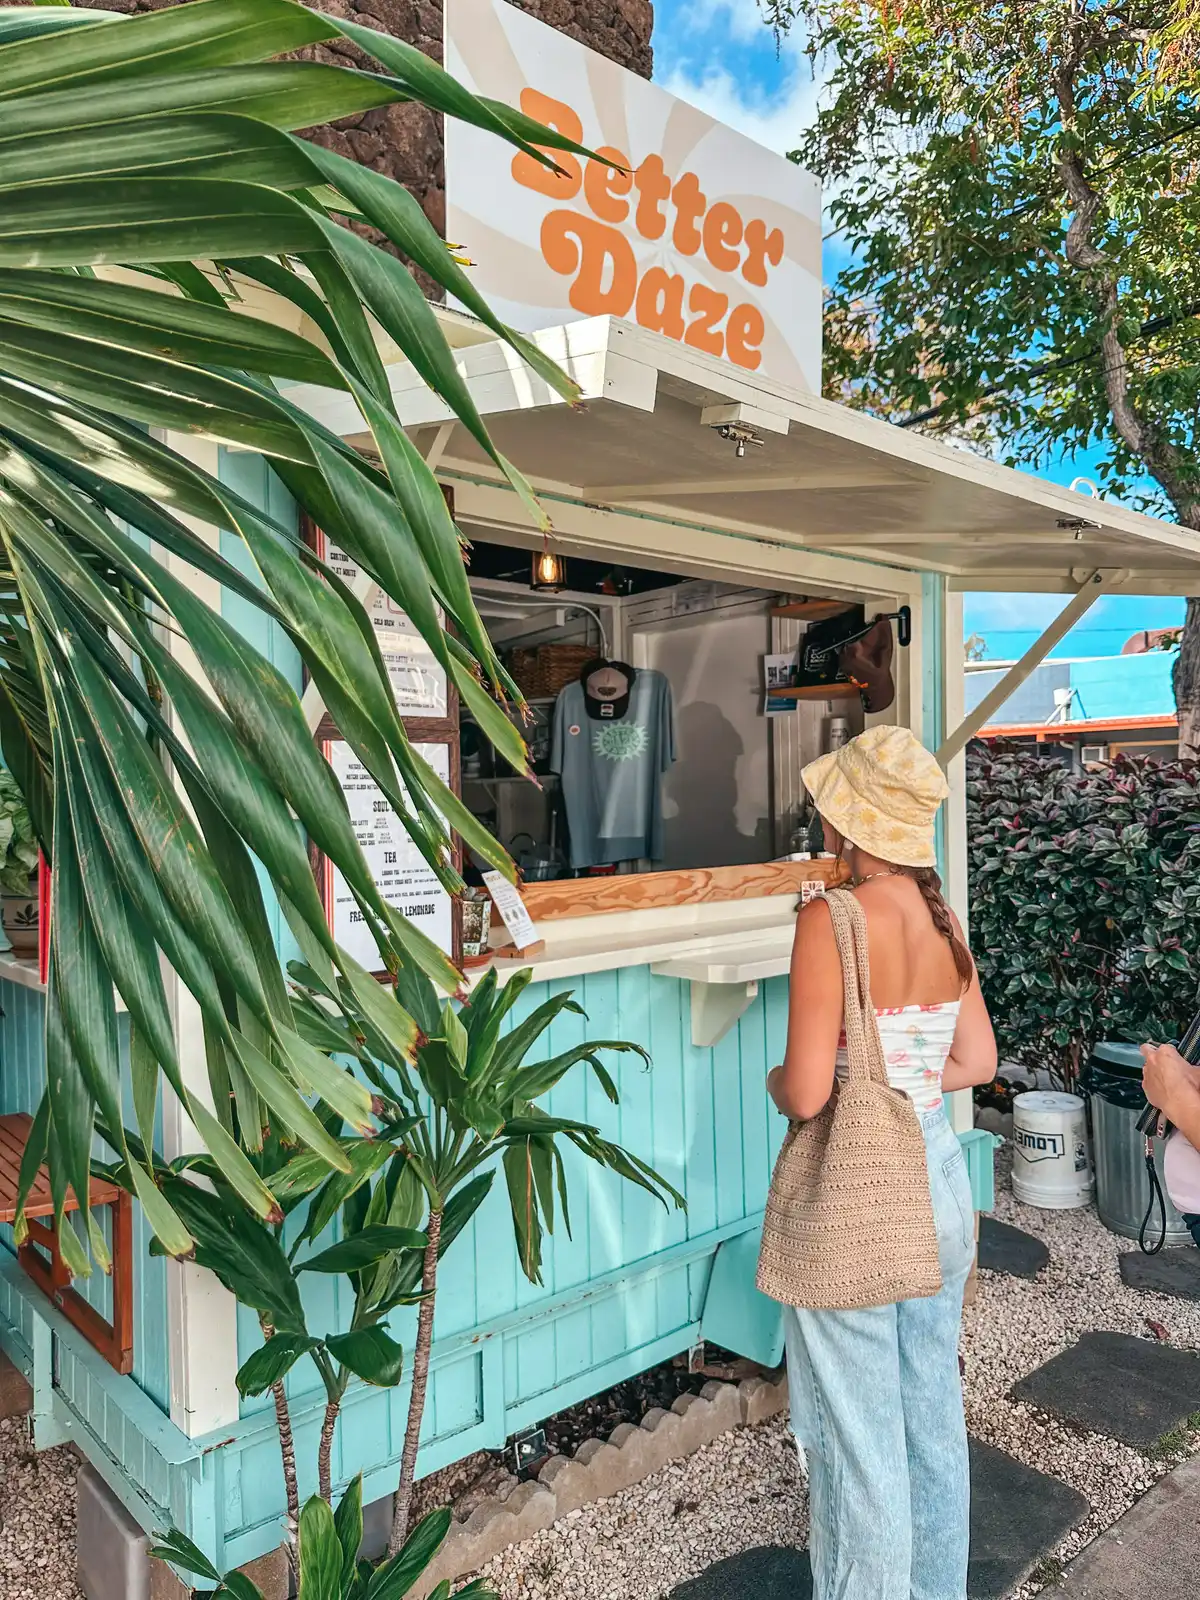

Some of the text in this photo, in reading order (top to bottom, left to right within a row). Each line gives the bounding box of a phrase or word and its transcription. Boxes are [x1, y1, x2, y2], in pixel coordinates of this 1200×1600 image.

[511, 87, 784, 287] Better
[540, 209, 765, 371] Daze
[373, 801, 389, 812] SOUL
[384, 851, 397, 863] TEA
[405, 904, 435, 917] LEMONADE
